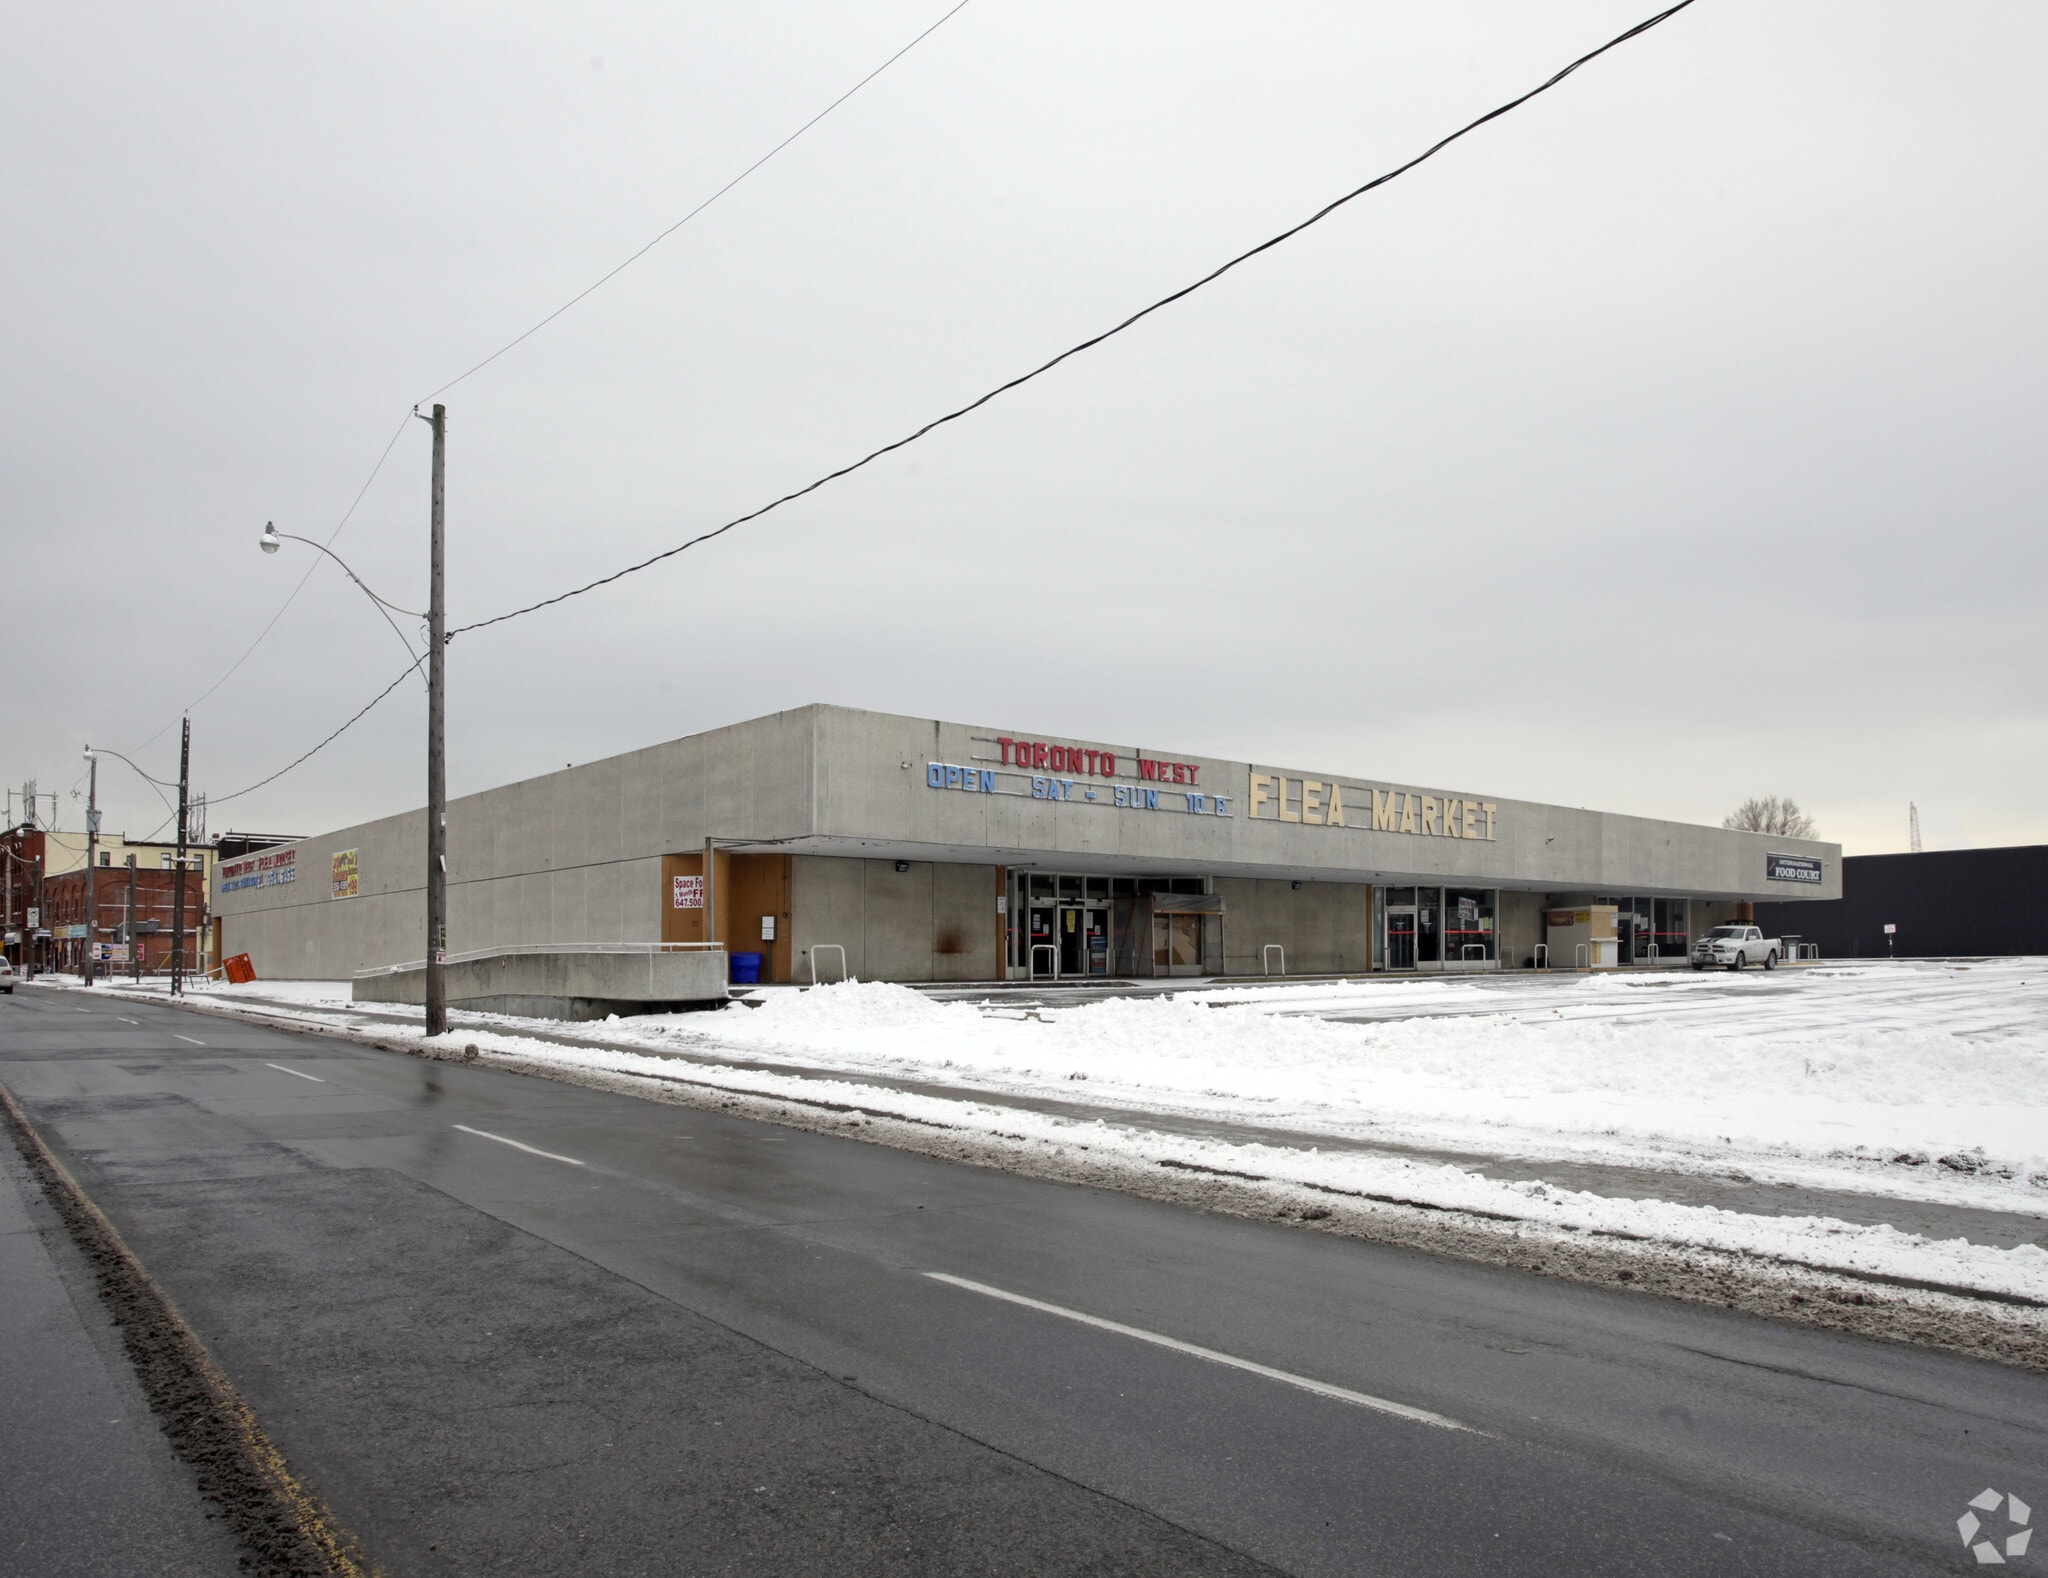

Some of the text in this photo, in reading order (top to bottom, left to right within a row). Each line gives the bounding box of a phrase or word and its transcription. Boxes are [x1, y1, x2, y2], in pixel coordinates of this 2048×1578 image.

[997, 737, 1200, 786] TORONTO WEST
[927, 762, 995, 794] OPEN
[1032, 775, 1074, 801] SAT
[1114, 784, 1159, 810] SUN
[1187, 792, 1205, 814] 10
[1215, 795, 1227, 816] 6
[1249, 773, 1497, 841] FLEA MARKET
[675, 877, 703, 891] Space Fo
[1775, 867, 1820, 880] FOOD COURT
